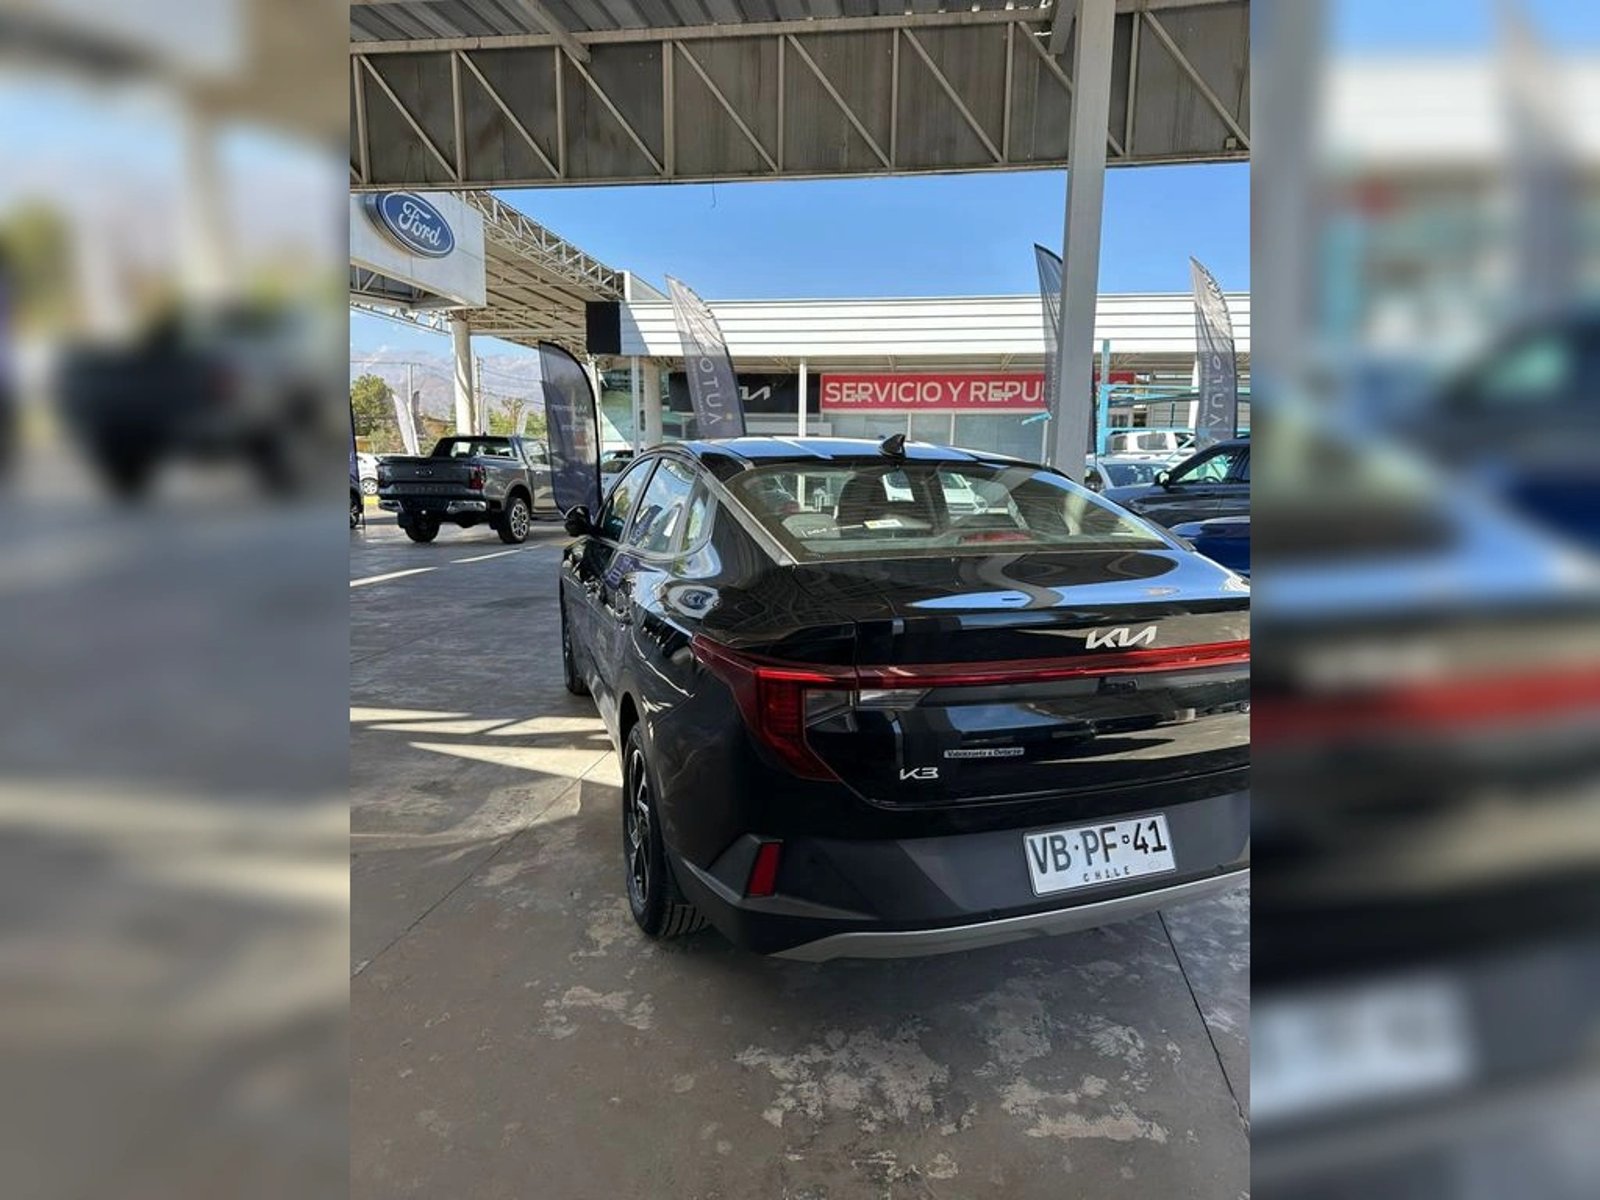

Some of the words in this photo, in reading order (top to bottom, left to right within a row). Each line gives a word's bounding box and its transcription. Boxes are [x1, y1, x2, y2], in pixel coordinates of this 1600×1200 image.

[398, 201, 442, 246] Ford
[824, 381, 942, 403] SERVICIO
[947, 381, 965, 402] Y
[969, 381, 1045, 402] REPU
[1085, 625, 1158, 650] KIA
[899, 767, 939, 780] K3
[1083, 866, 1130, 882] CHILE
